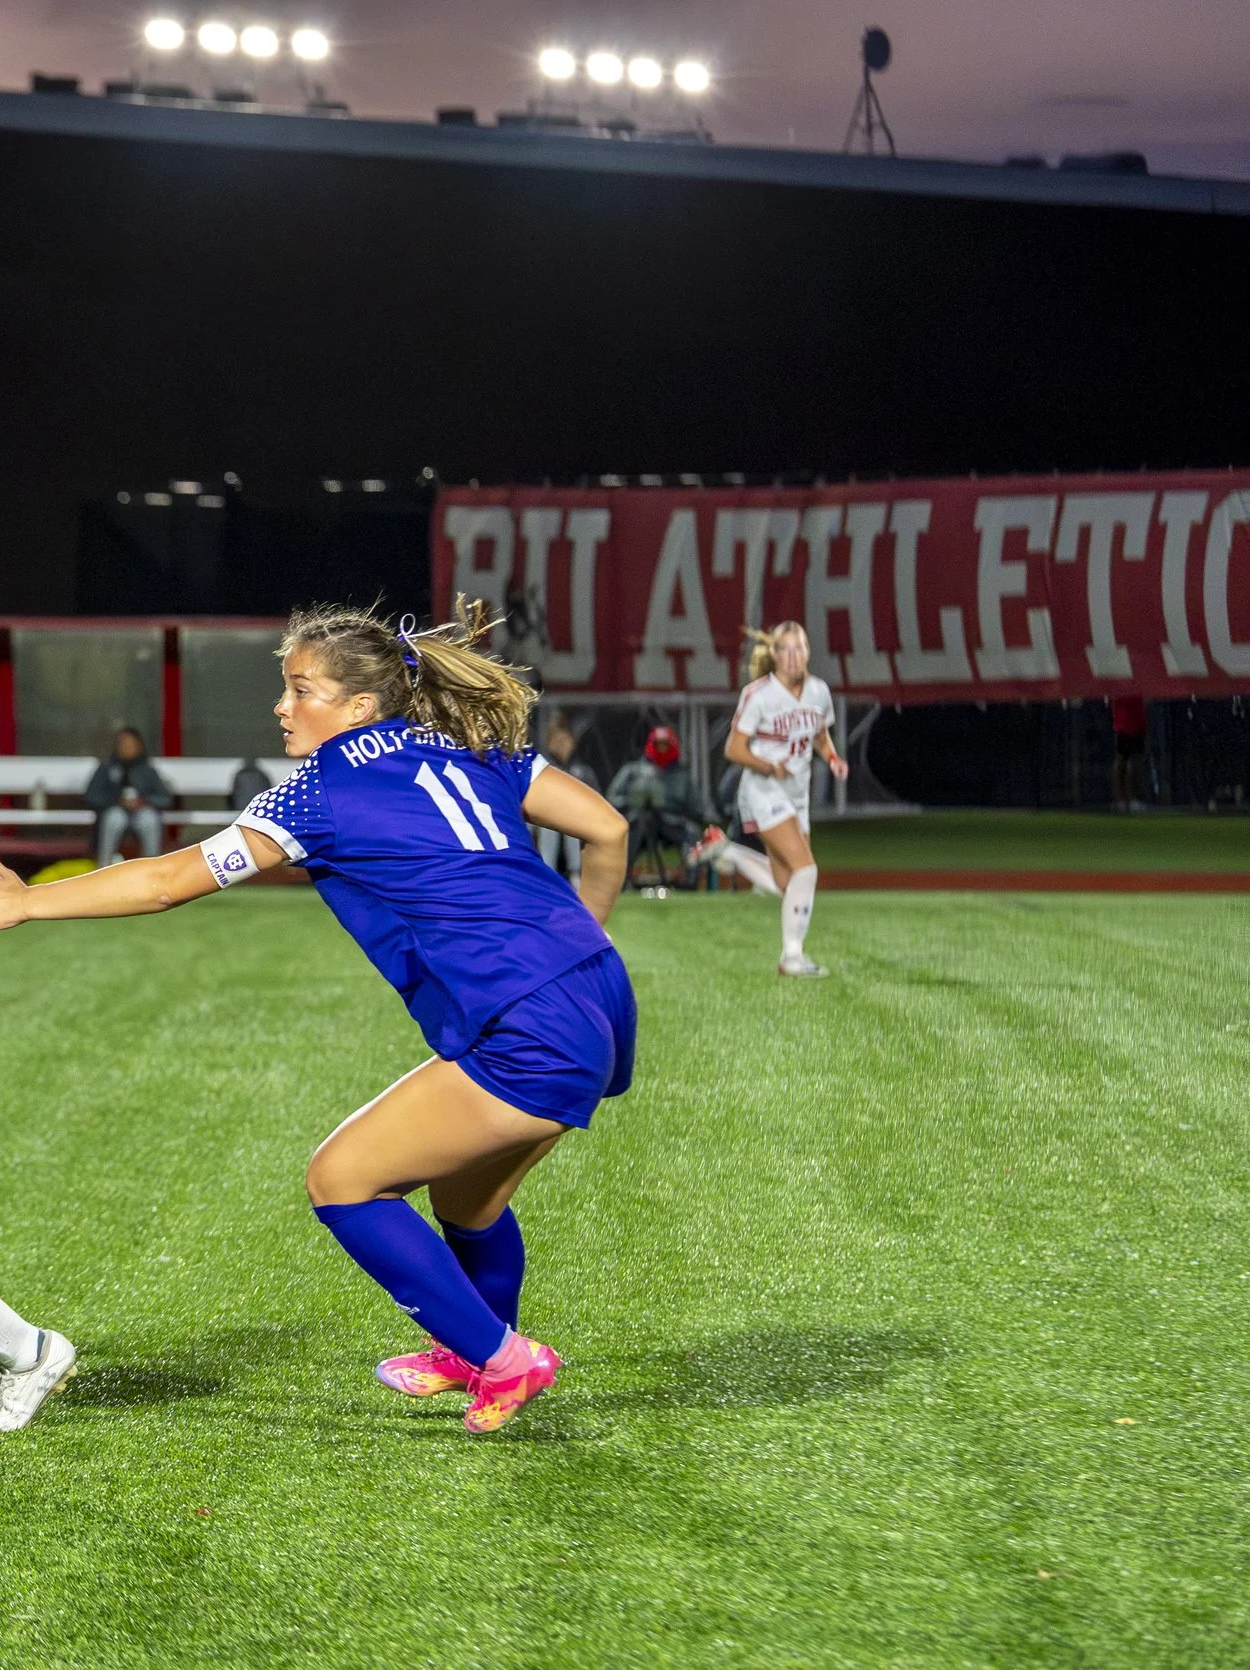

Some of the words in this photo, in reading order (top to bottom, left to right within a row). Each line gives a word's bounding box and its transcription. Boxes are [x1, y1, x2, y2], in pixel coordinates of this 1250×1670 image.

[444, 505, 611, 682] BU
[414, 759, 510, 850] 11
[206, 852, 230, 886] CAPTAIN
